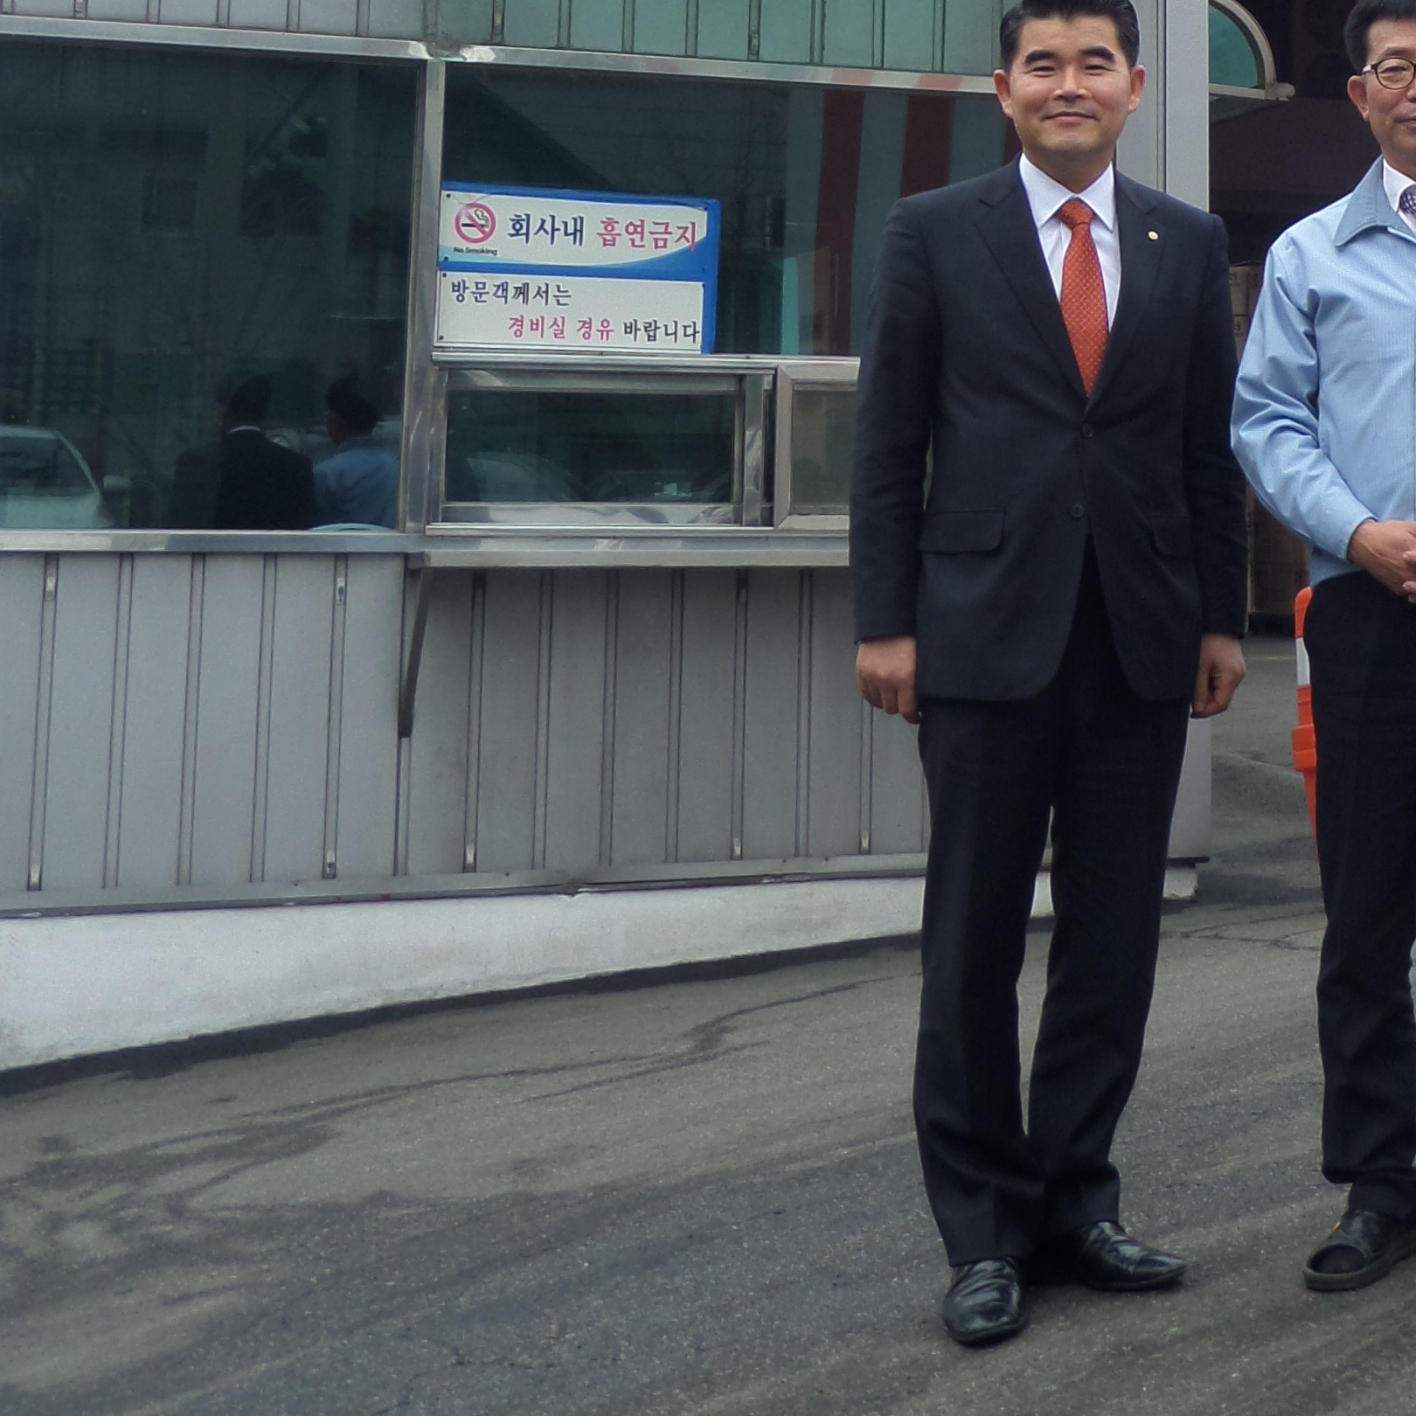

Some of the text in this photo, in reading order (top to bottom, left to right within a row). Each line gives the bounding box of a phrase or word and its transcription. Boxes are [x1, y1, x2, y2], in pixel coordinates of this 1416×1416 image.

[508, 213, 698, 252] 회사내 흡연금지
[453, 246, 498, 257] No Smoking
[451, 279, 572, 307] 방문객께서는
[508, 315, 700, 344] 경비실 경유 바랍니다
